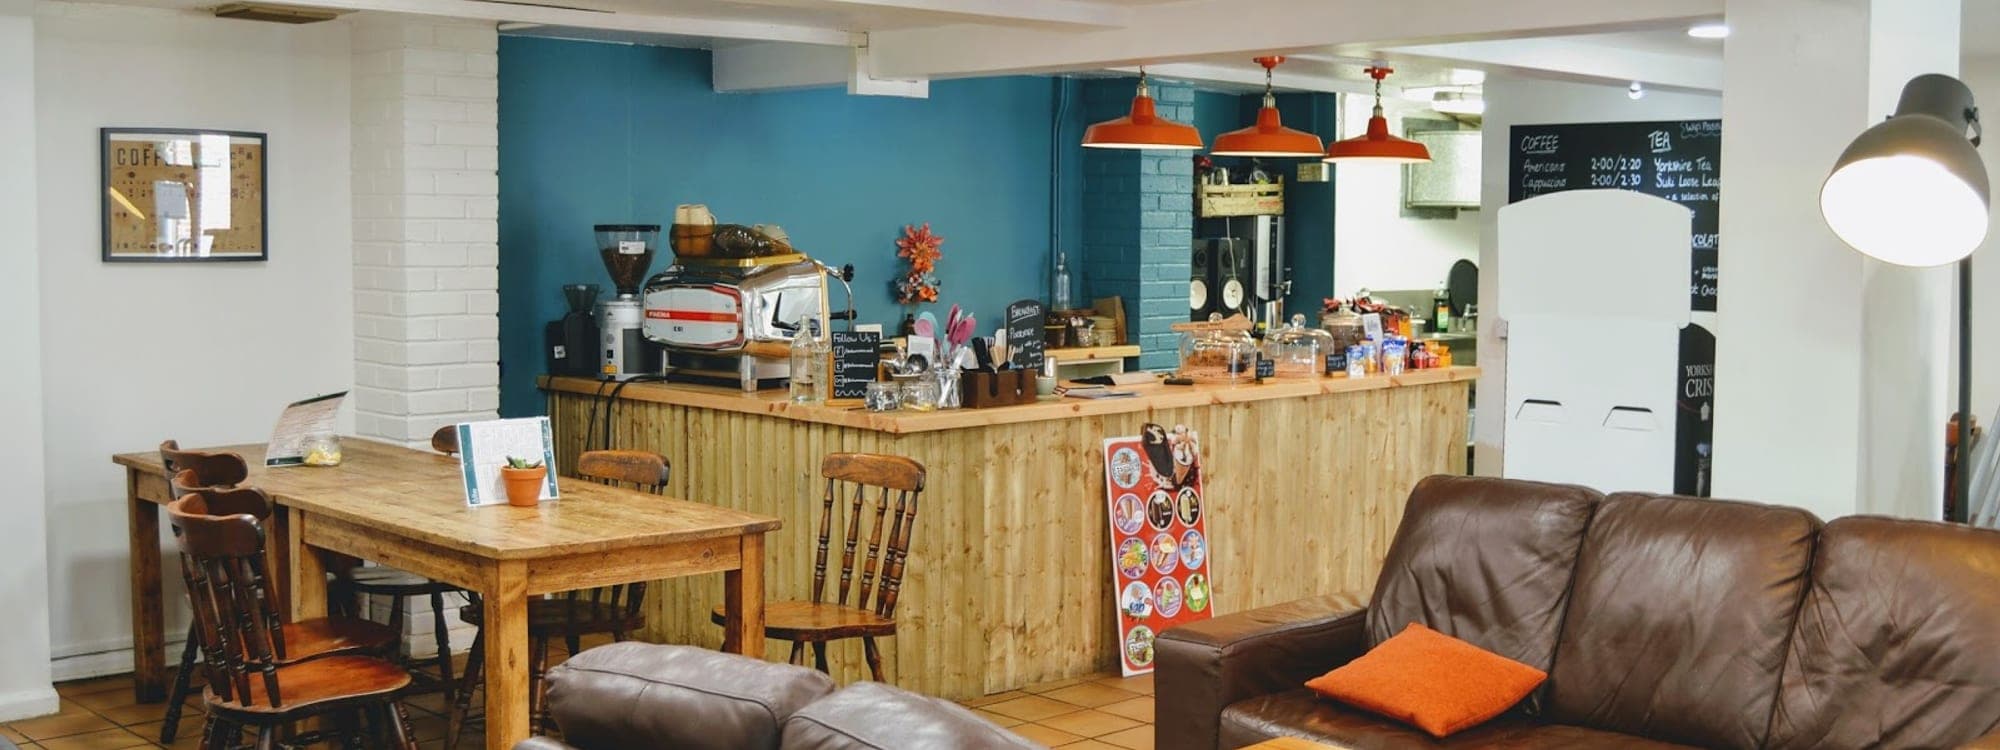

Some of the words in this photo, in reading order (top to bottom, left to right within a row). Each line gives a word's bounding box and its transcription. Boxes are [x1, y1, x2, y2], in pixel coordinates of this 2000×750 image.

[1521, 135, 1559, 152] COFFEE
[1648, 131, 1671, 150] TEA
[1696, 156, 1712, 171] Tea
[833, 333, 858, 343] Follow
[1685, 378, 1713, 398] CRIS
